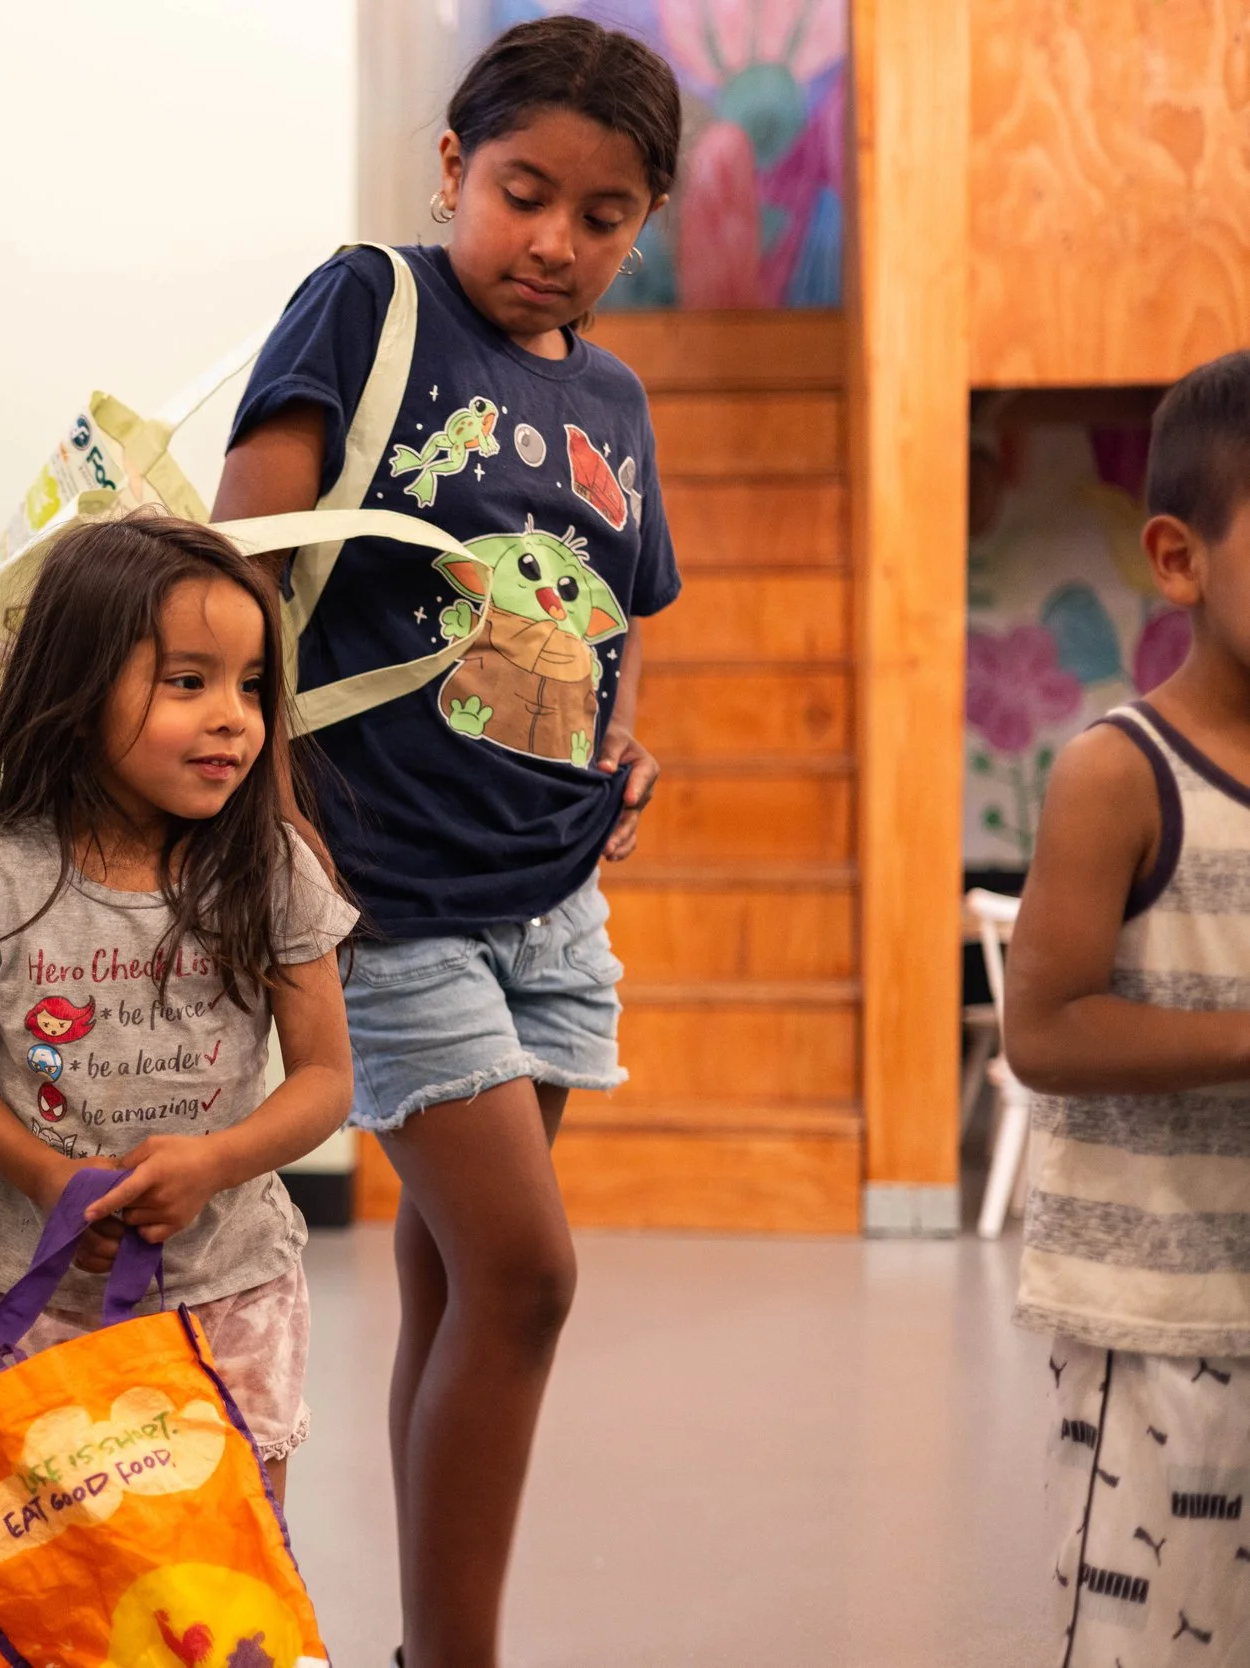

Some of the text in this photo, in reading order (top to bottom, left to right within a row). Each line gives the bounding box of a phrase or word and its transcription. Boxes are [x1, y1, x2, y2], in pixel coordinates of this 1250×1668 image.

[28, 948, 84, 985] Hero
[92, 947, 167, 983] Check
[119, 999, 206, 1030] be fierce
[88, 1045, 201, 1078] be a leader
[81, 1097, 199, 1125] be amazing
[68, 1444, 94, 1467] IS
[2, 1495, 49, 1538] EAT
[50, 1472, 109, 1511] GOOD
[1172, 1491, 1243, 1520] PUMA
[1081, 1563, 1149, 1604] PUMA
